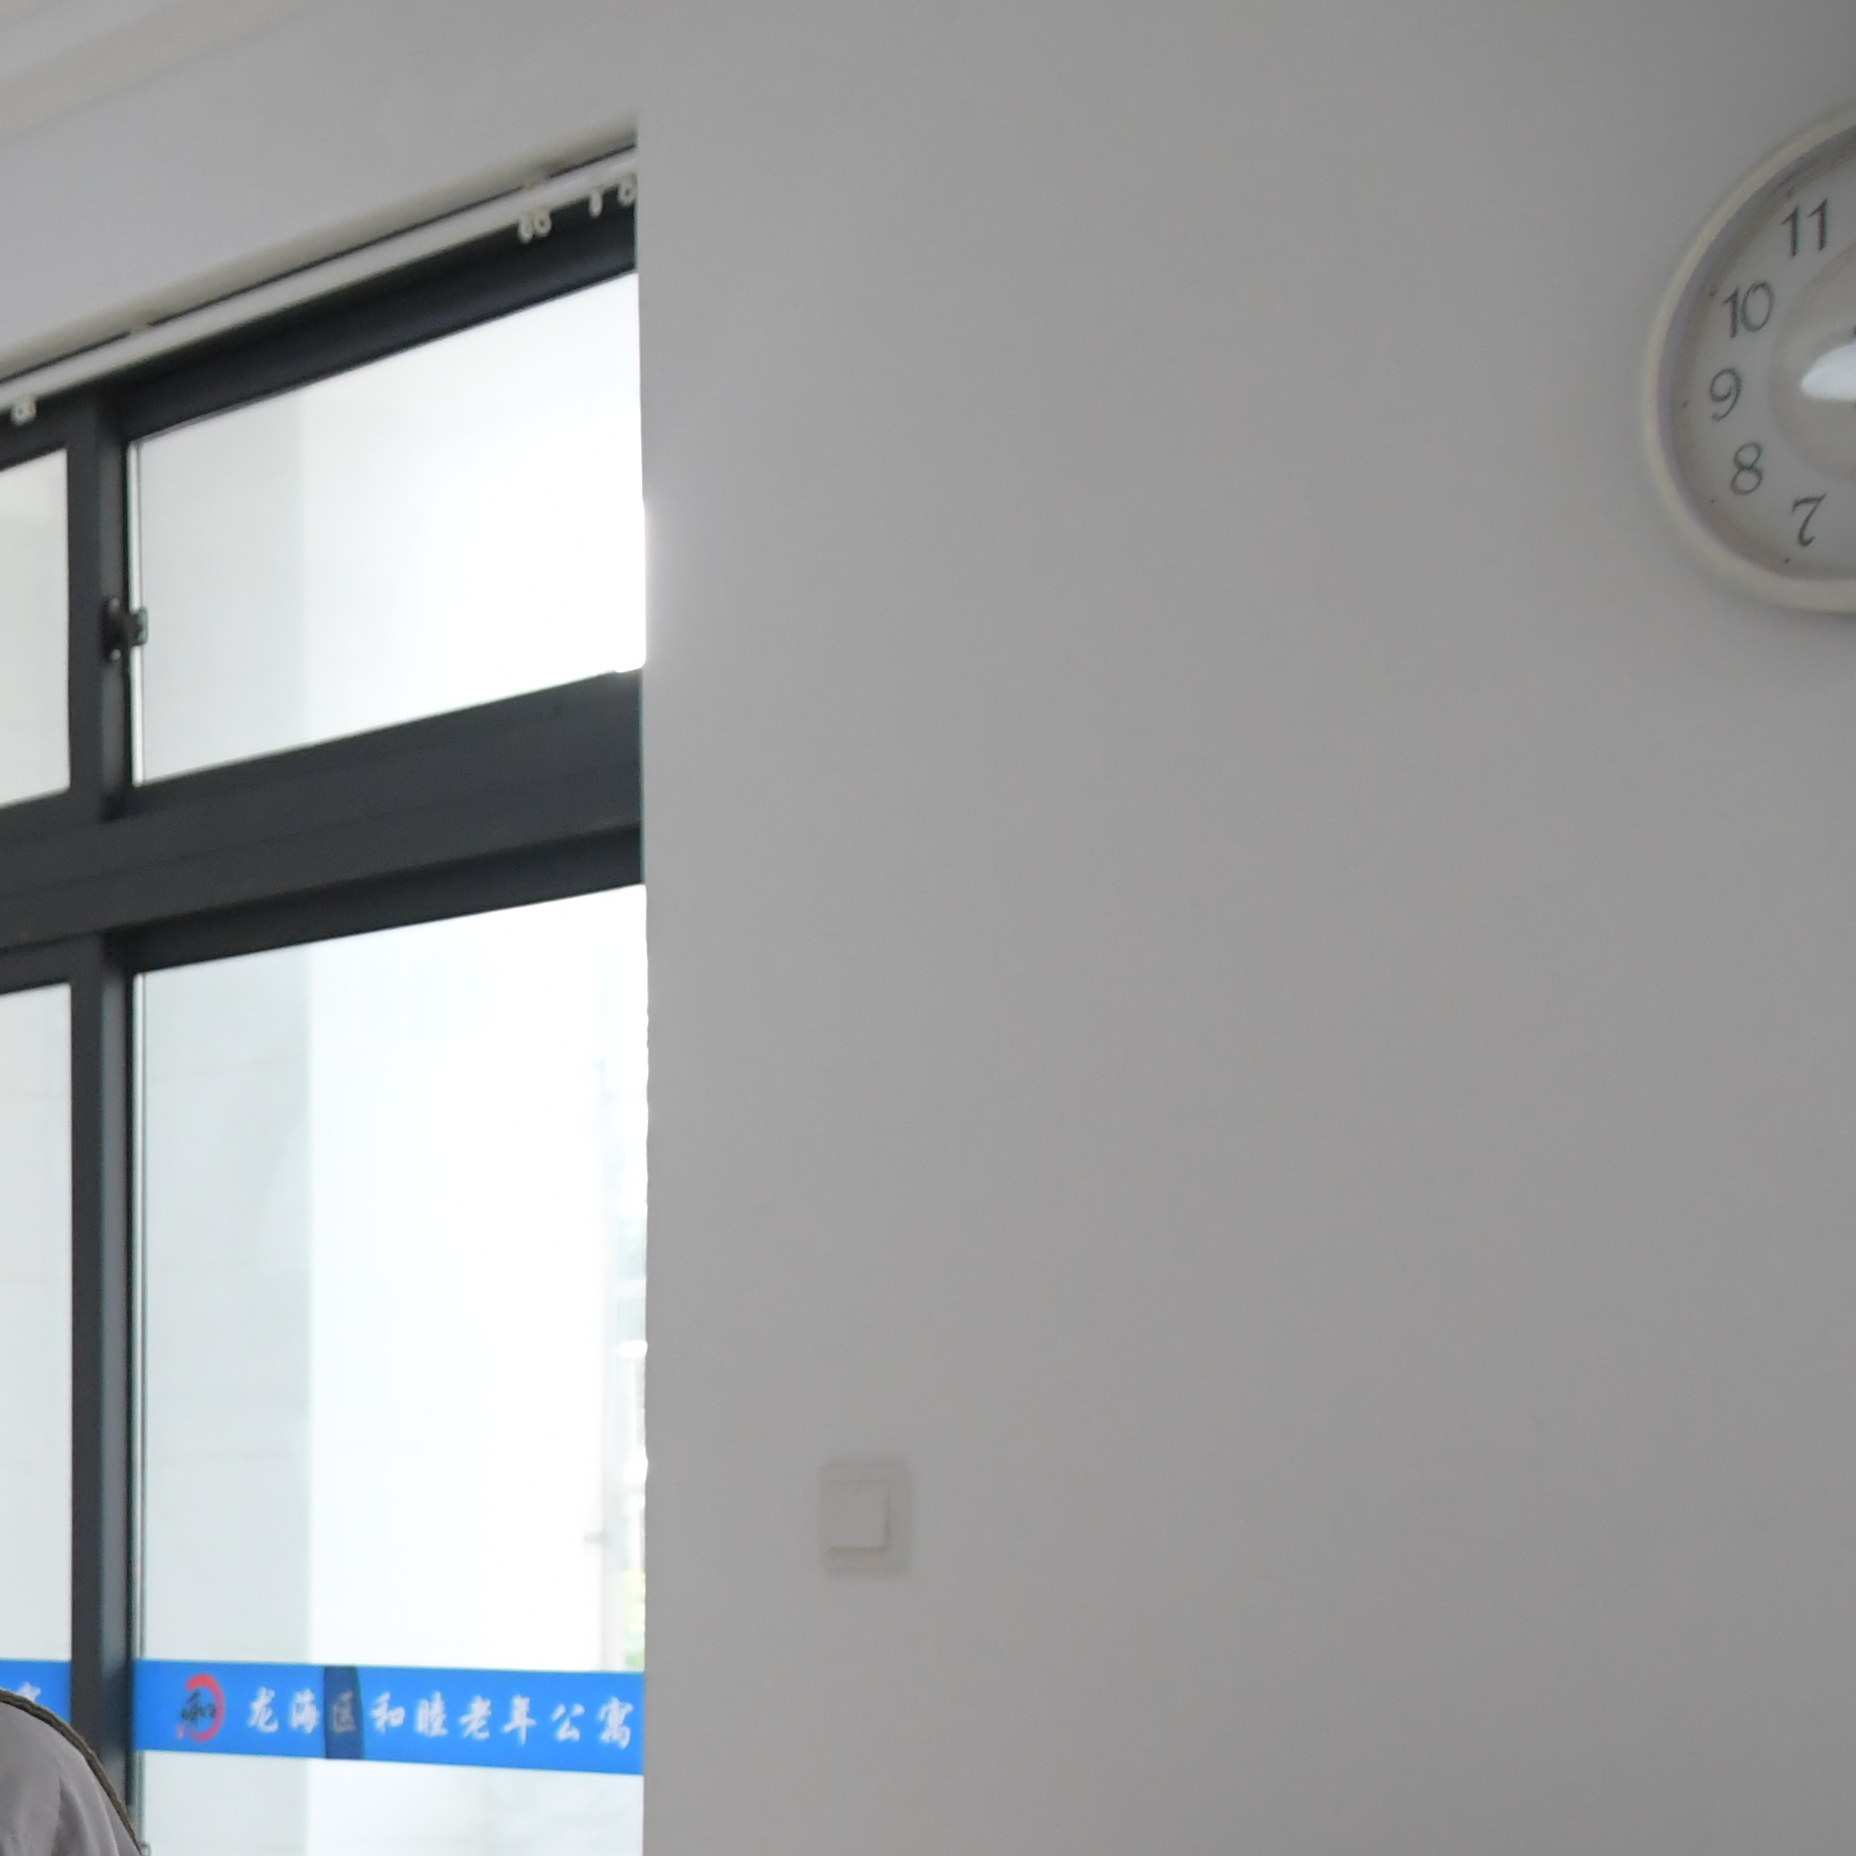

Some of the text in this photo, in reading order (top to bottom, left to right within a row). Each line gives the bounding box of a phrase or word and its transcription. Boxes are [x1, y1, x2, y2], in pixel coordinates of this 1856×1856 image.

[1781, 198, 1829, 258] 11
[1722, 280, 1774, 339] 10
[1709, 368, 1742, 422] 9
[1730, 442, 1763, 496] 8
[1791, 493, 1828, 547] 7
[248, 1685, 634, 1749] 龙海区和睦老年公寓
